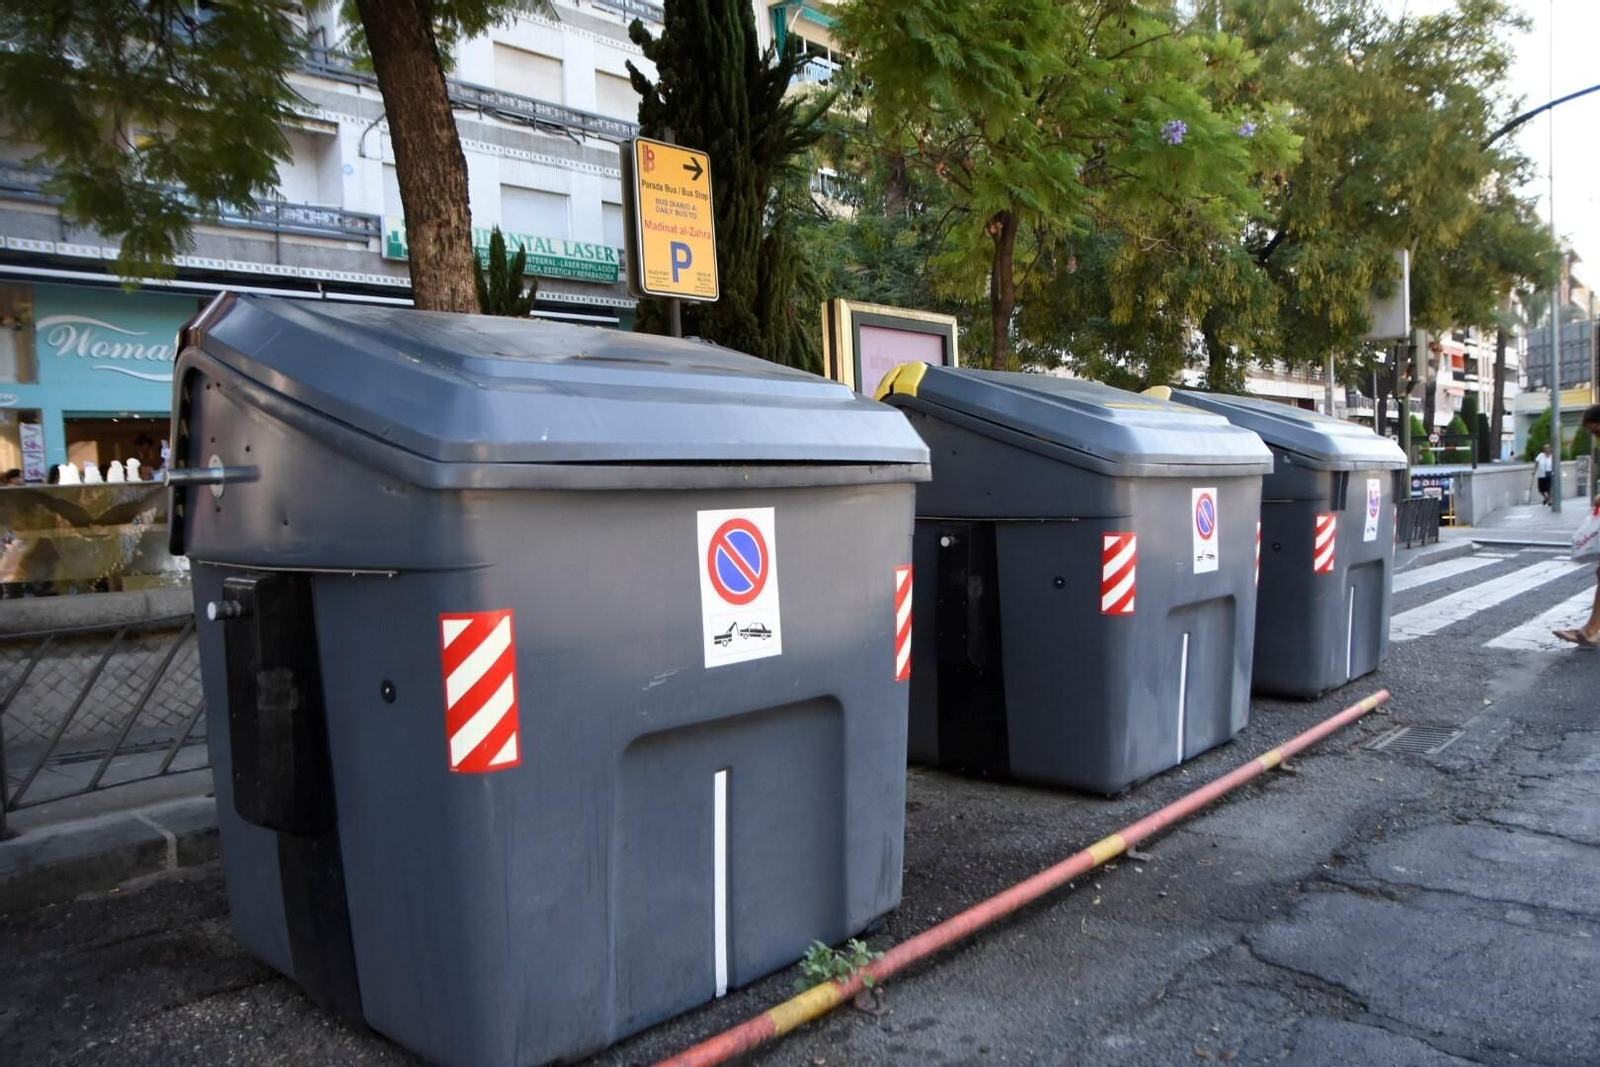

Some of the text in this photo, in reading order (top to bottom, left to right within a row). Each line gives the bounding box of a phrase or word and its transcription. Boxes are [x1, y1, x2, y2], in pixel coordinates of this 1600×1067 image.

[641, 179, 664, 191] Parada
[664, 183, 677, 195] Bus
[681, 187, 694, 197] Bus
[694, 189, 709, 201] Stop
[644, 219, 712, 239] Madinat al-Zahra
[564, 241, 616, 262] LASER
[670, 240, 693, 284] P
